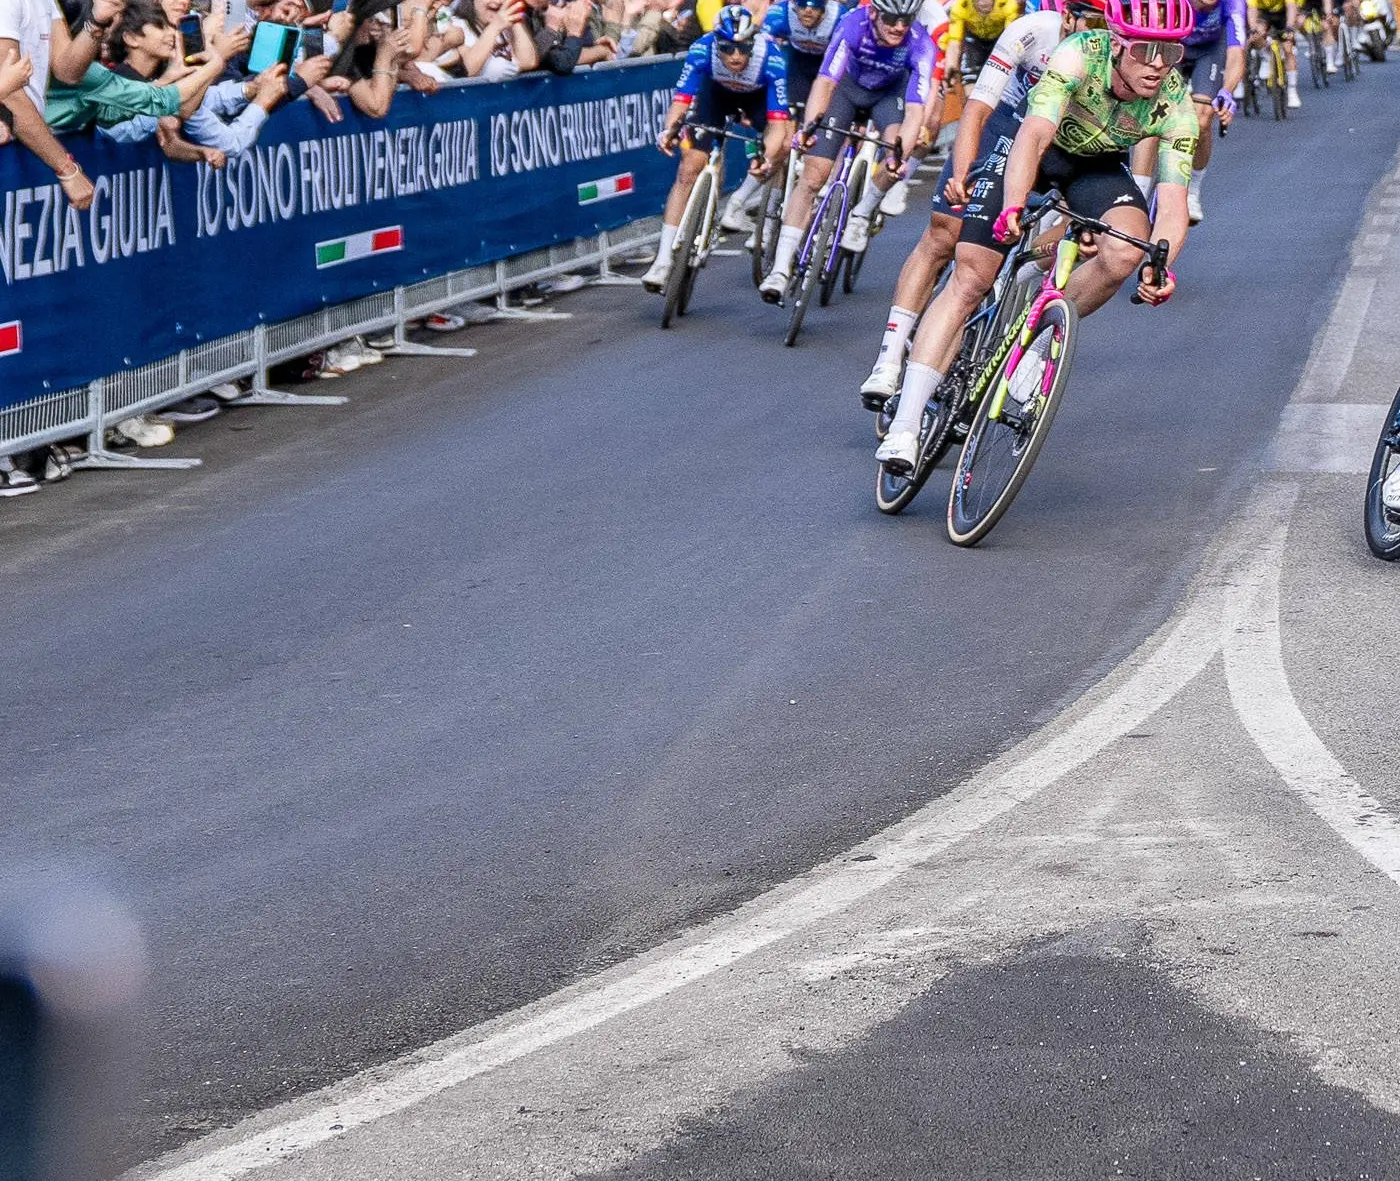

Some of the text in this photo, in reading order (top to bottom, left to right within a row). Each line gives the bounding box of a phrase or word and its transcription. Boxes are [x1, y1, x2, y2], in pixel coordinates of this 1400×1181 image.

[226, 142, 297, 232] SONO
[299, 133, 360, 215] FRIULI
[359, 125, 428, 205] VENEZIA
[428, 118, 480, 193] GIULIA
[490, 113, 509, 177] IO
[510, 105, 561, 172] SONO
[559, 99, 600, 162] FRIULI
[600, 92, 651, 155] VENEZIA
[0, 161, 176, 286] NEZIA GIULIA
